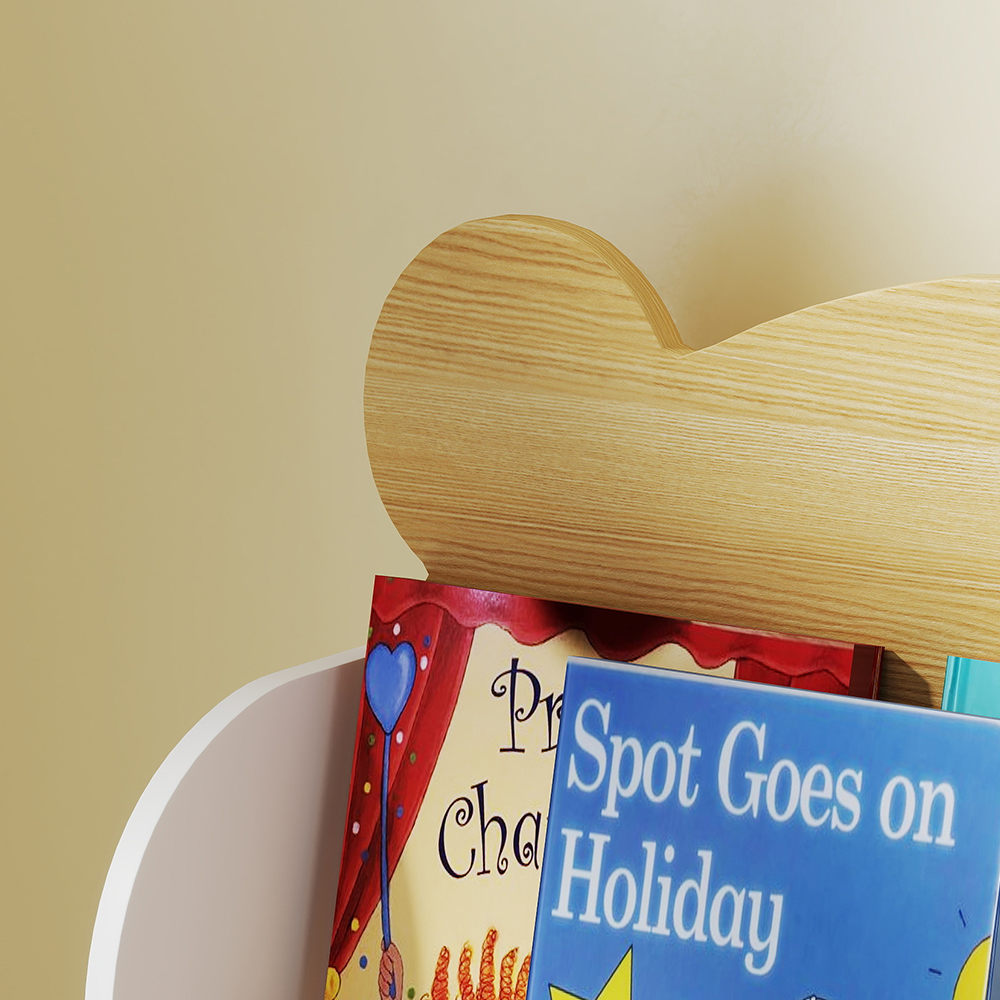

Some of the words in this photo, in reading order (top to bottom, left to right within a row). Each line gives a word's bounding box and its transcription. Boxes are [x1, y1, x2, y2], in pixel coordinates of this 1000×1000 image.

[438, 779, 549, 879] Cha
[567, 698, 701, 818] Spot
[718, 721, 863, 832] Goes
[880, 776, 956, 847] on
[551, 827, 784, 976] Holiday
